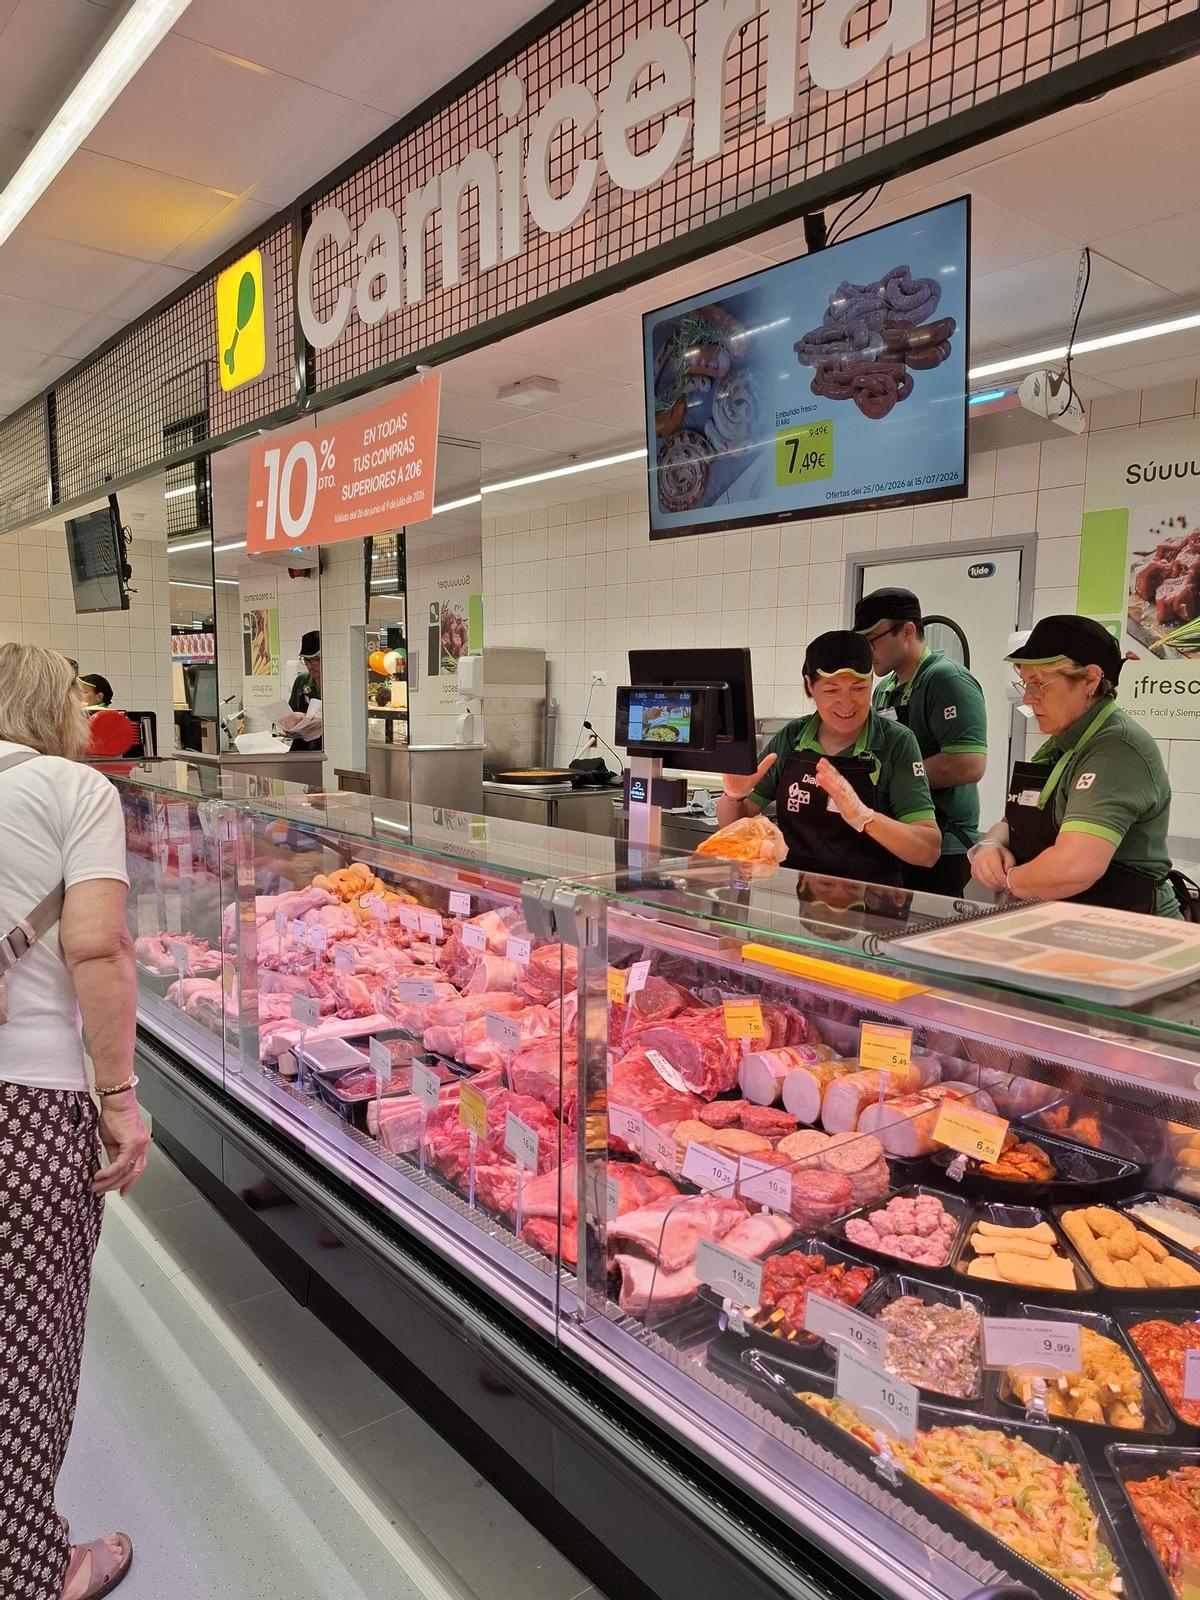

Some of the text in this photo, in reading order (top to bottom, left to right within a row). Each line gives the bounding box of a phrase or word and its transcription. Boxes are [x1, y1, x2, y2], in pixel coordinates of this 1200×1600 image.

[775, 403, 817, 419] Embutido fresco
[775, 417, 790, 427] El kilo
[363, 412, 408, 446] EN TODAS
[320, 437, 336, 472] %
[352, 435, 415, 474] TUS COMPRAS
[784, 438, 826, 474] 7,49€
[318, 474, 336, 490] DTO.
[341, 459, 423, 501] SUPERIORES A 20€
[825, 490, 851, 500] Ofertas
[851, 486, 862, 497] del
[863, 480, 906, 494] 25/06/2026
[914, 471, 959, 486] 15/07/2026
[363, 508, 369, 517] de
[390, 499, 396, 509] de
[406, 495, 412, 505] de
[1134, 675, 1200, 699] ¡fresc
[1150, 707, 1168, 717] Fácil
[1169, 710, 1175, 718] y
[801, 773, 822, 788] Dia
